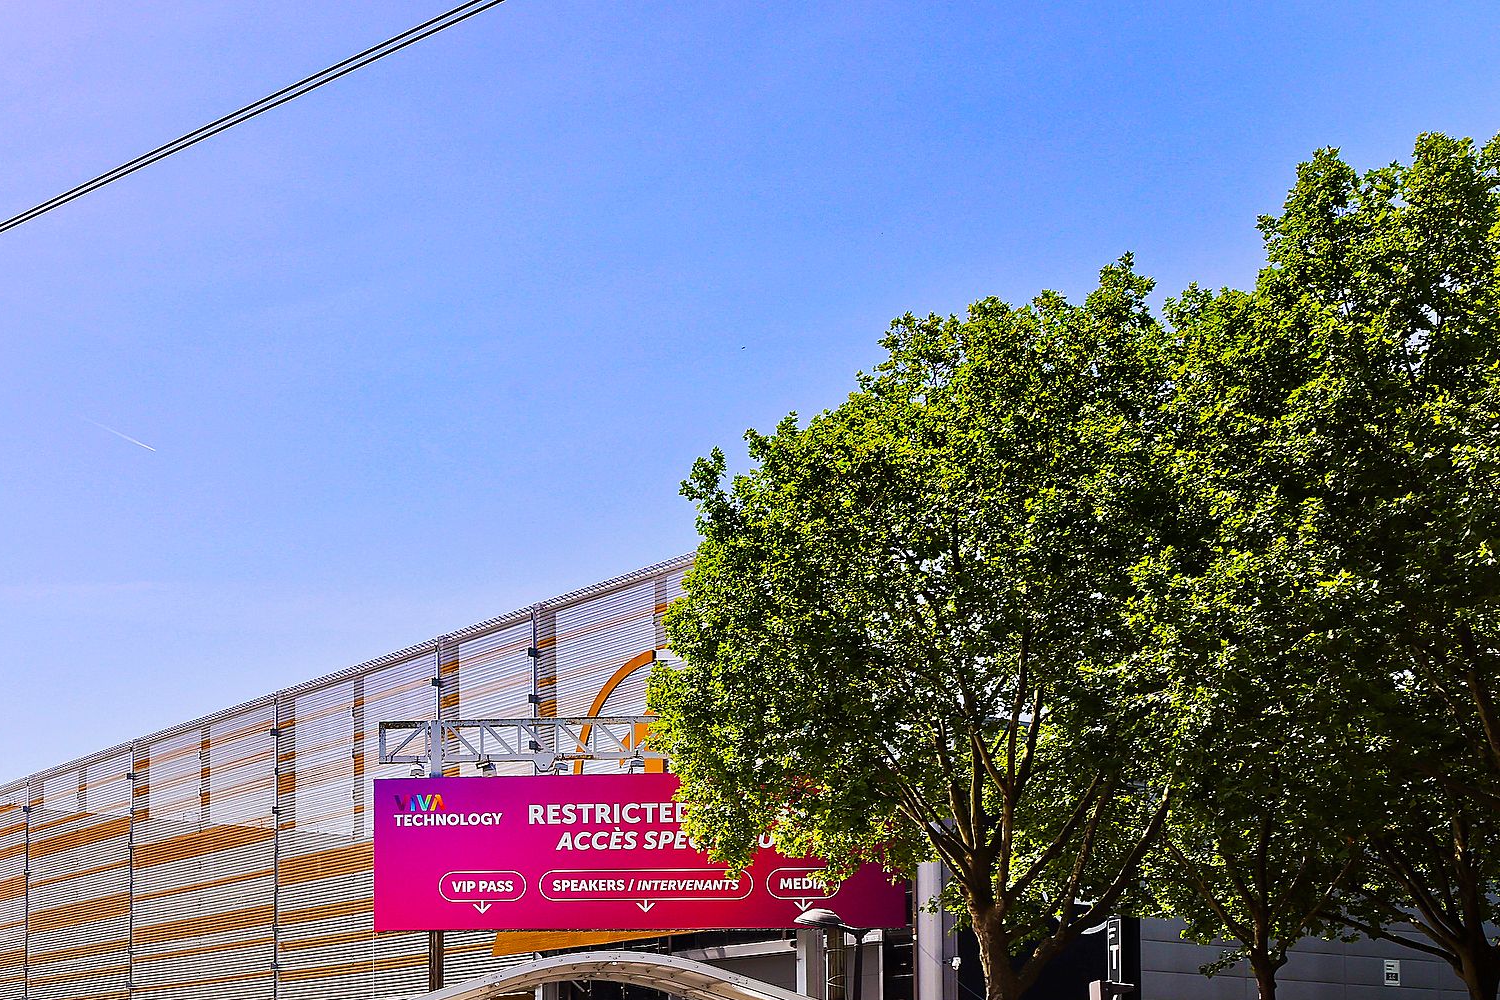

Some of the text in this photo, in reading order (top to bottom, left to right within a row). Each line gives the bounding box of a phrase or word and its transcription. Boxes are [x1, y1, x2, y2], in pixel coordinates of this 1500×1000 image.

[394, 794, 446, 812] VIVA
[394, 812, 503, 827] TECHNOLOGY
[555, 826, 638, 851] ACCÈS
[452, 880, 514, 893] VIP PASS
[552, 879, 625, 892] SPEAKERS
[636, 879, 739, 892] INTERVENANTS
